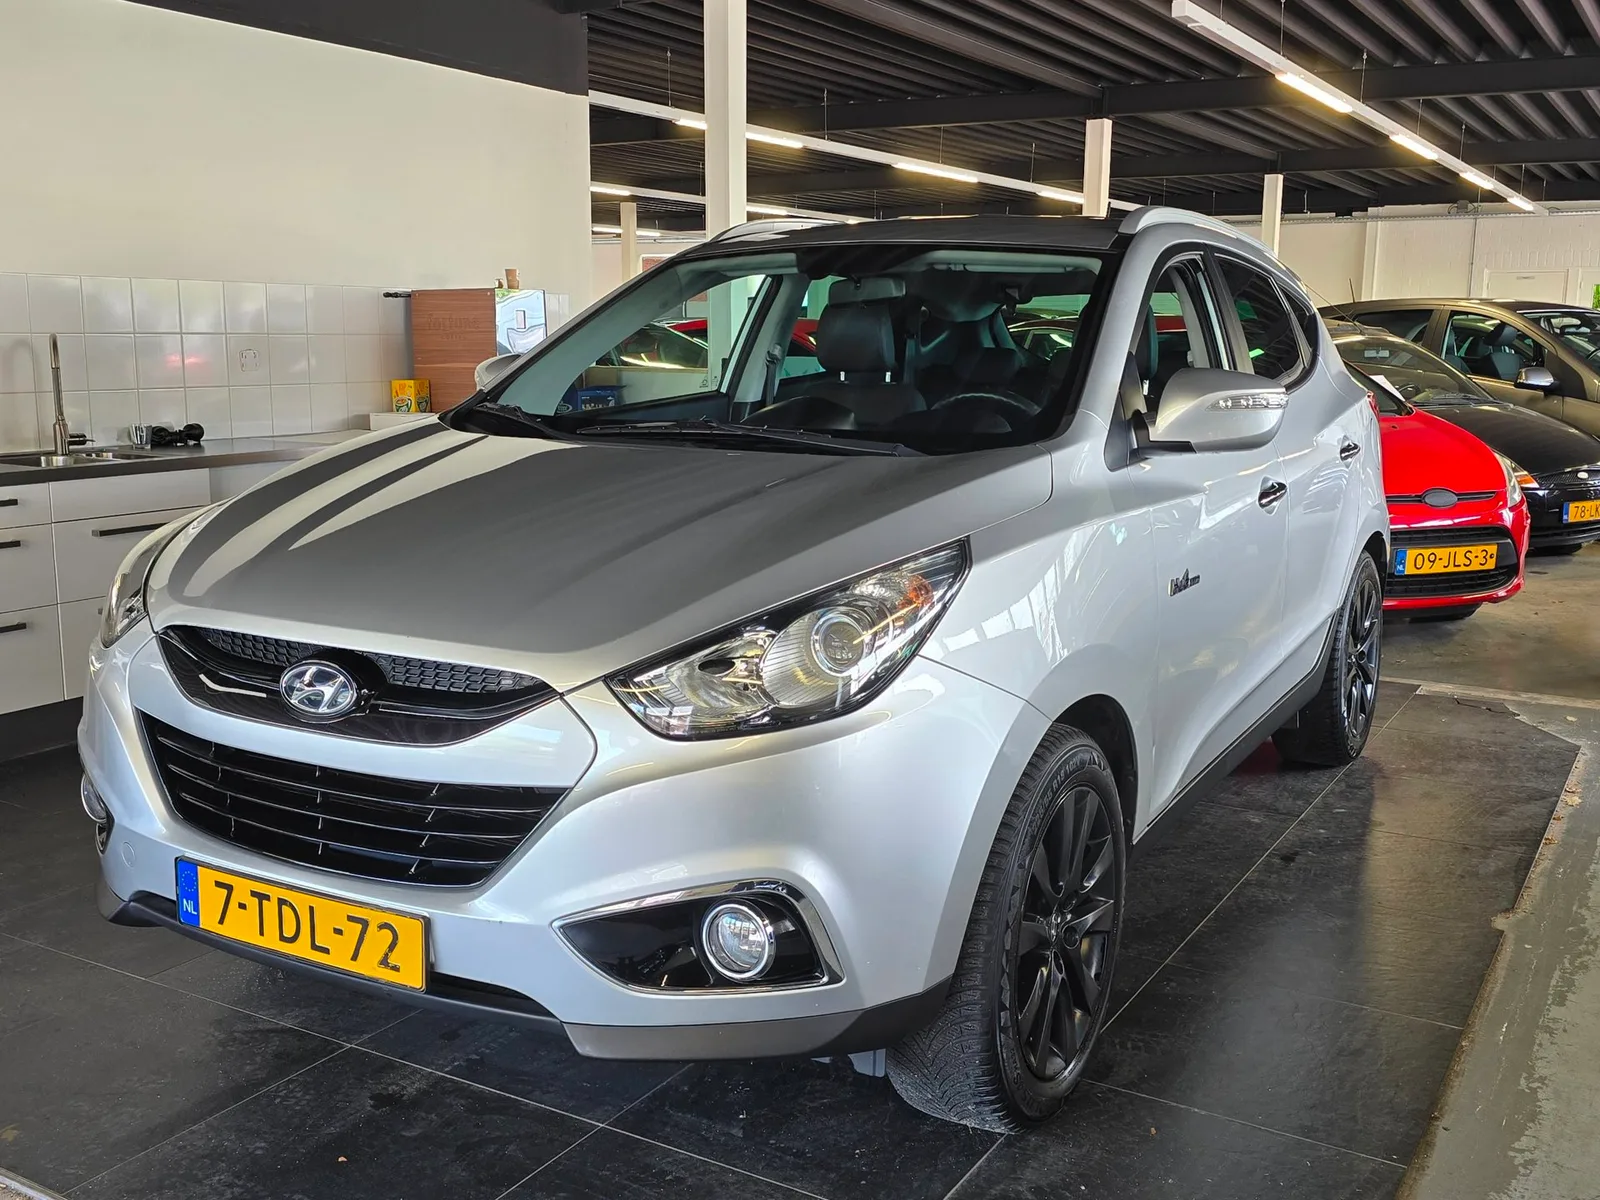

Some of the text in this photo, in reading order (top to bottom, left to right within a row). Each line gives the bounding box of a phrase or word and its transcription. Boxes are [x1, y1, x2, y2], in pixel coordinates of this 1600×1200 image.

[1413, 548, 1489, 570] 09-JLS-3
[182, 898, 198, 915] NL
[213, 880, 401, 973] 7-TDL-72
